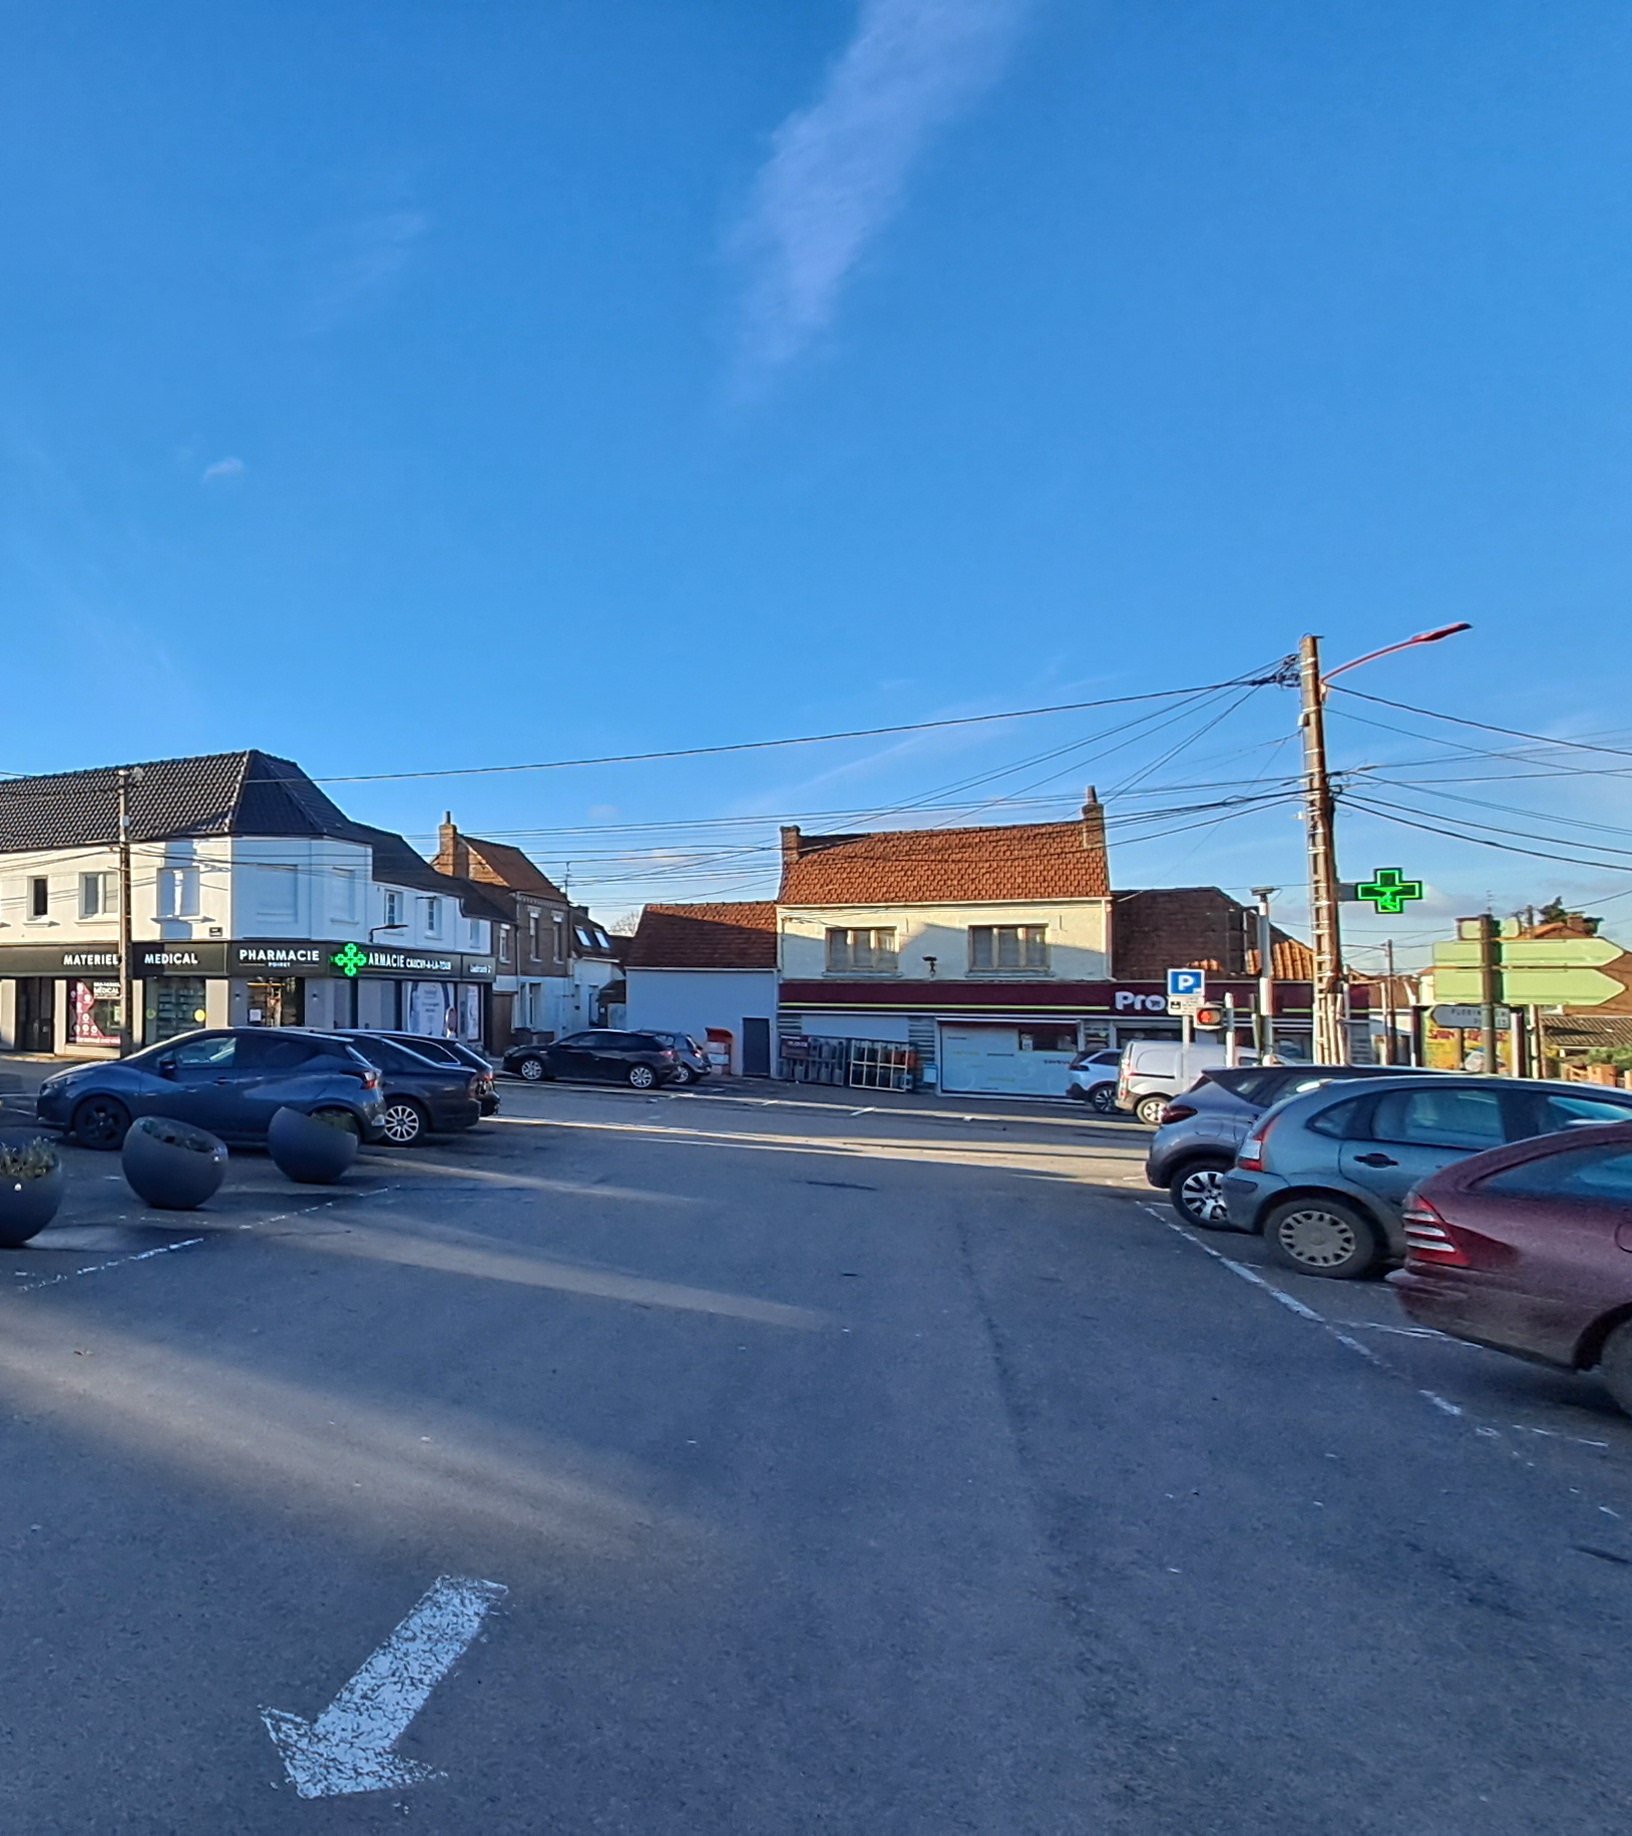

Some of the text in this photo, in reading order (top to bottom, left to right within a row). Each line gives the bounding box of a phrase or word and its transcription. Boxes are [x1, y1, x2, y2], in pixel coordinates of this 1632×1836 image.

[63, 953, 199, 965] MATERIEL MEDICAL
[239, 949, 320, 961] PHARMACIE
[368, 952, 404, 968] ARMACIE
[1178, 974, 1194, 990] P
